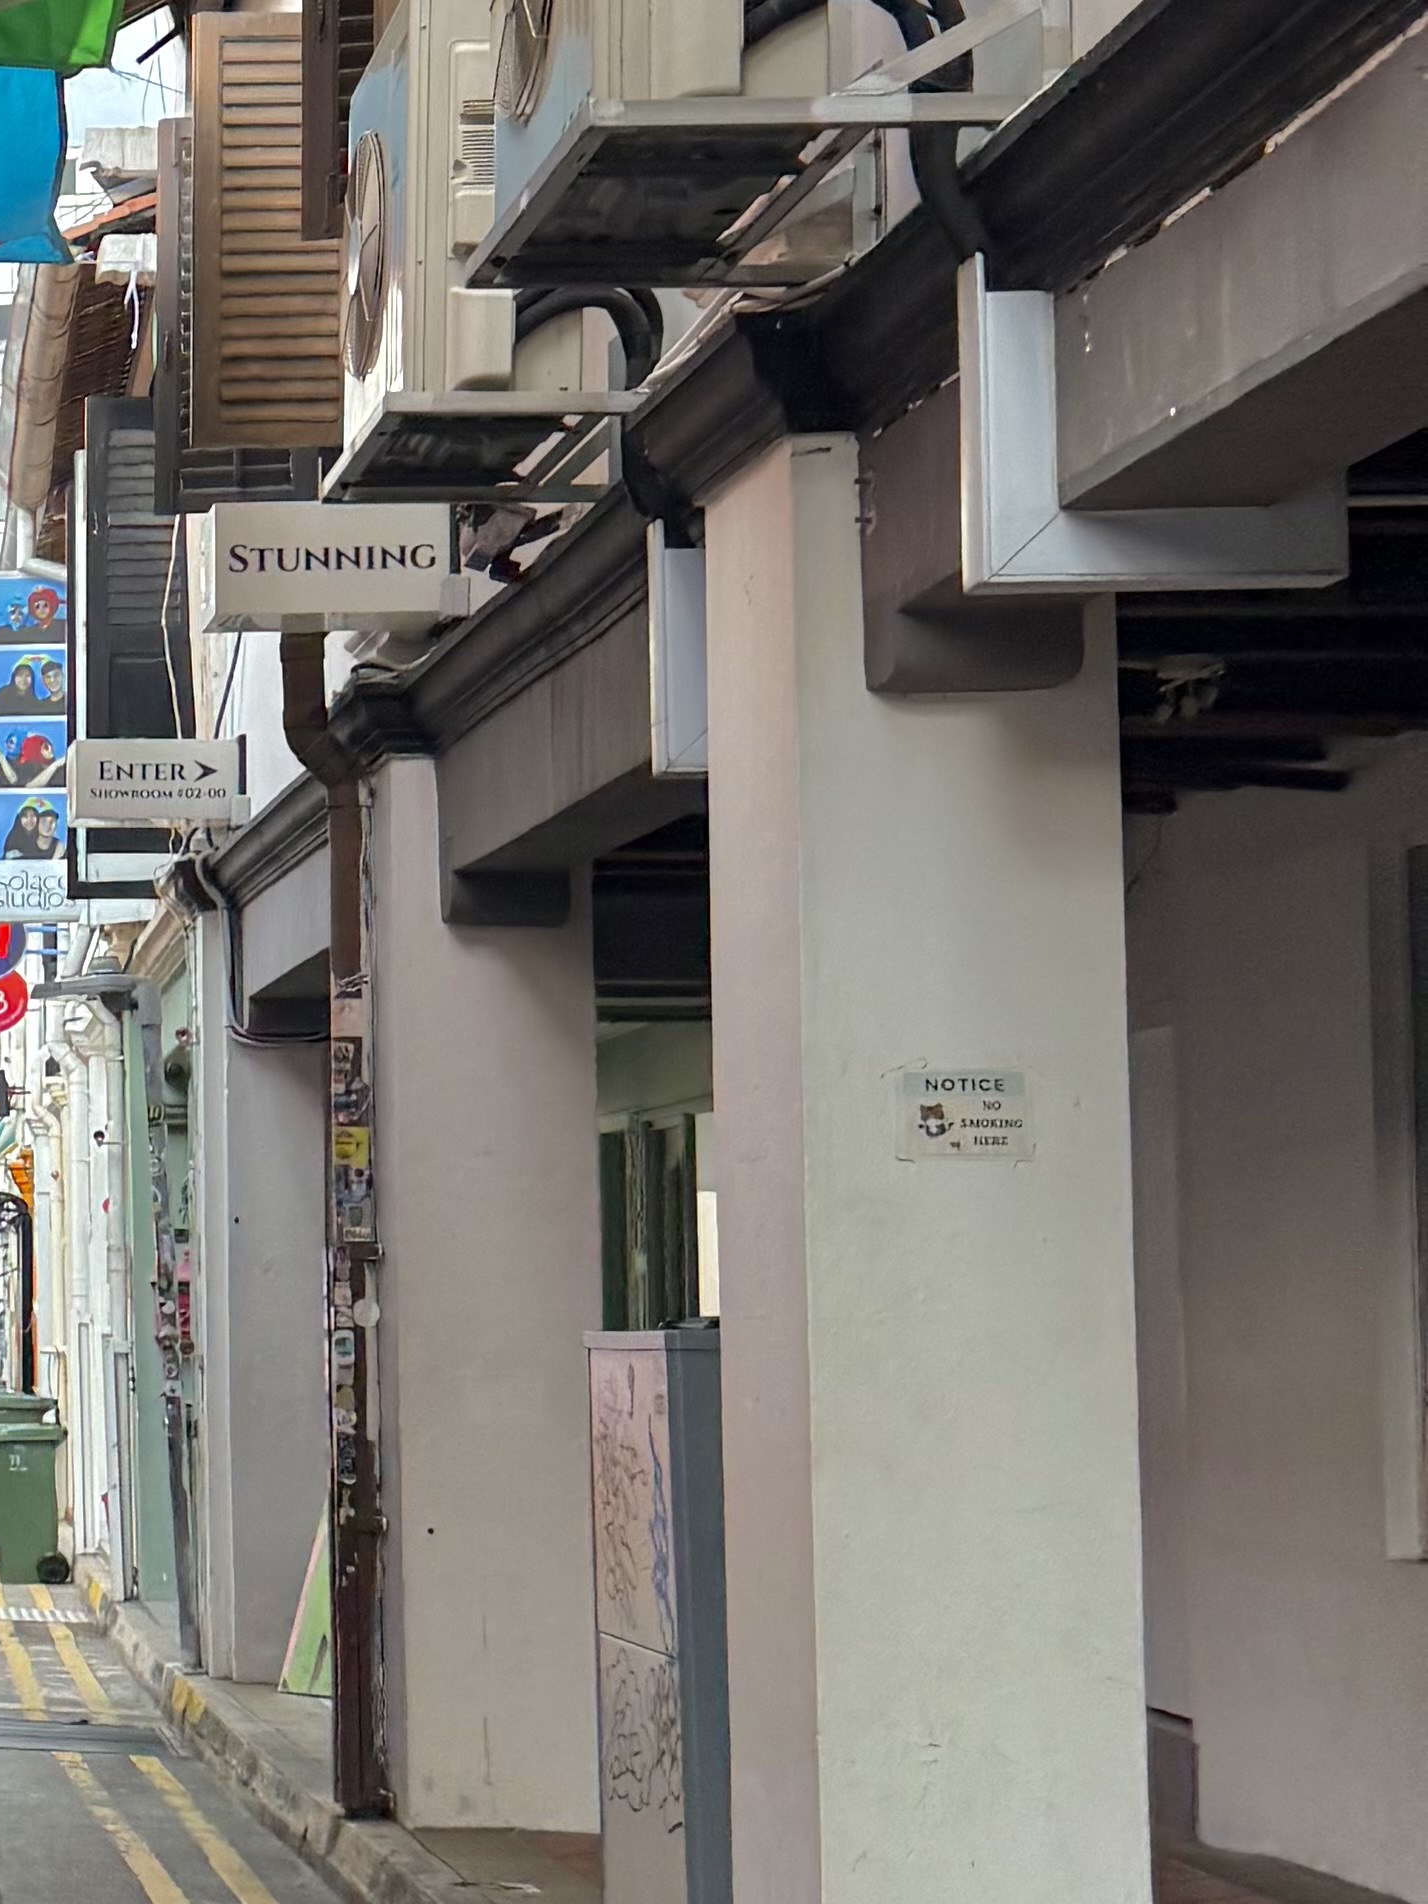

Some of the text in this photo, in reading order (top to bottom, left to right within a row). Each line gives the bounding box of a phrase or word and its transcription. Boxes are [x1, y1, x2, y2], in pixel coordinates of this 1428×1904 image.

[228, 543, 436, 573] STUNNING
[99, 760, 188, 781] ENTER
[90, 787, 173, 799] SHOWROOM
[925, 1078, 1005, 1092] NOTICE
[982, 1100, 1002, 1111] NO
[960, 1118, 1023, 1129] SMOKING
[974, 1136, 1009, 1146] HERE
